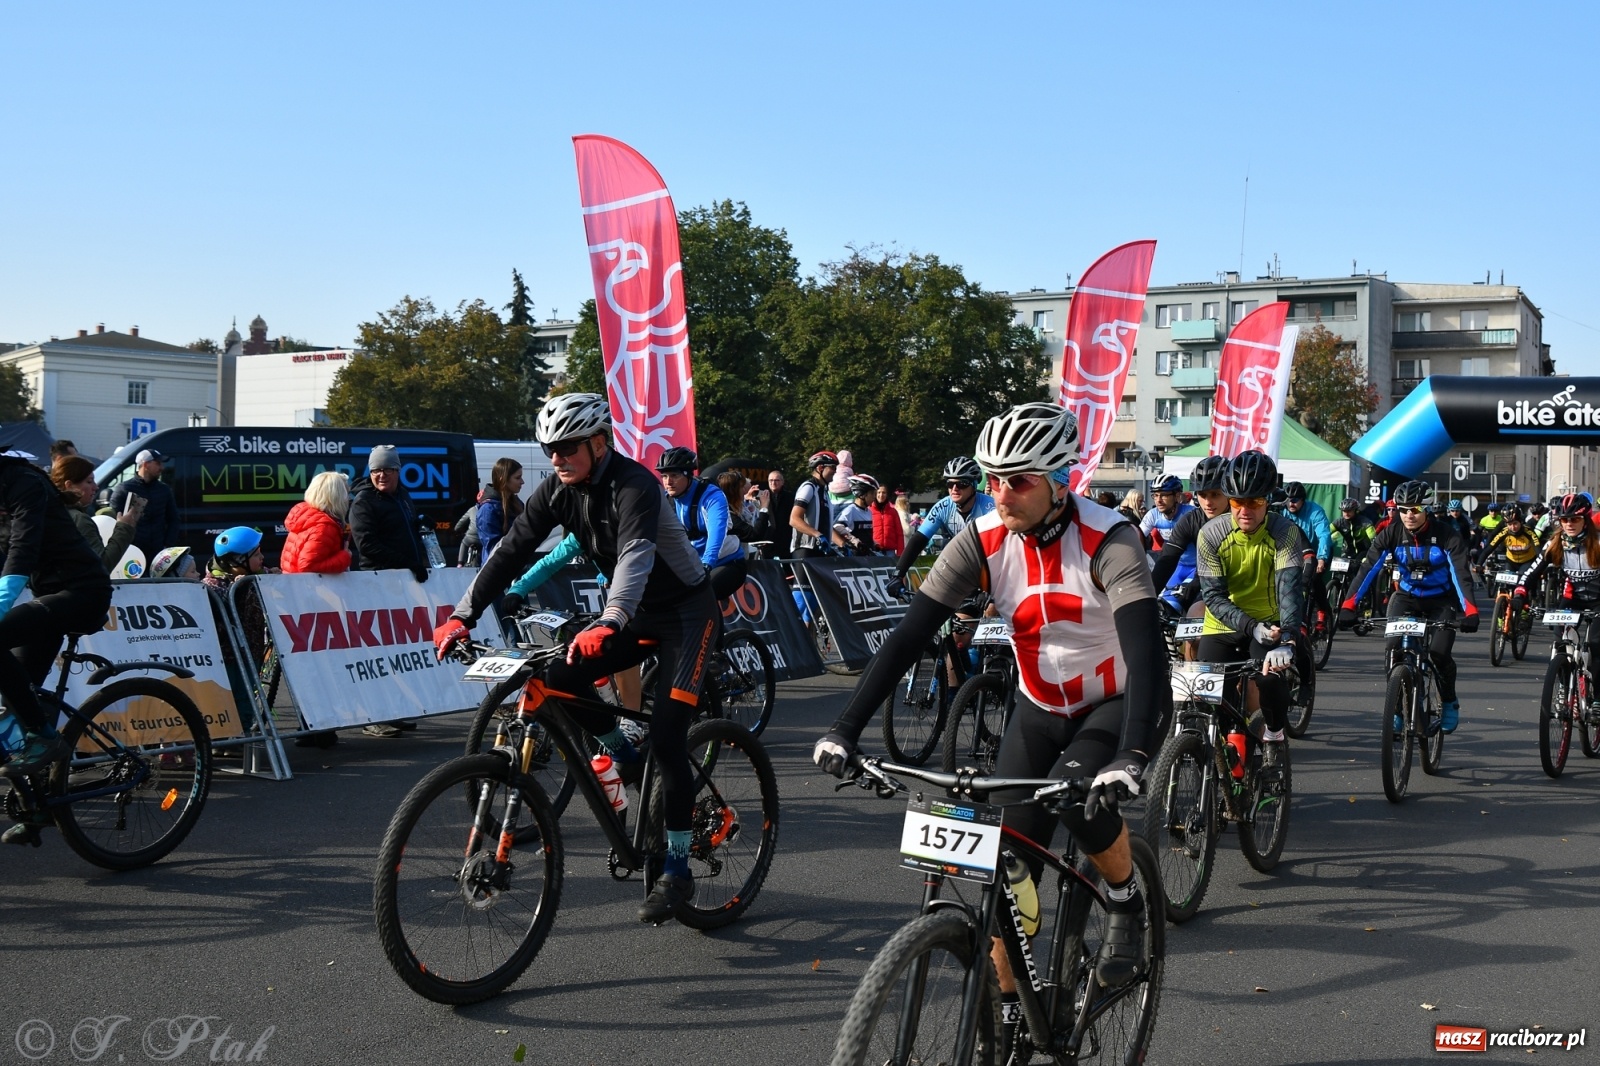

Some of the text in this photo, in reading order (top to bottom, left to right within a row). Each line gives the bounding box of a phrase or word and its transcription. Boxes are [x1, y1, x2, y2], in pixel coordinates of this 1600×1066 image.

[1497, 399, 1600, 426] bike ate
[240, 436, 346, 454] bike atelier
[200, 463, 448, 491] MTBMARAON
[434, 522, 451, 530] XIS
[103, 604, 167, 632] URUS
[344, 656, 389, 684] TAKE
[388, 648, 434, 676] MORE
[476, 662, 514, 674] 1467
[919, 824, 984, 854] 1577
